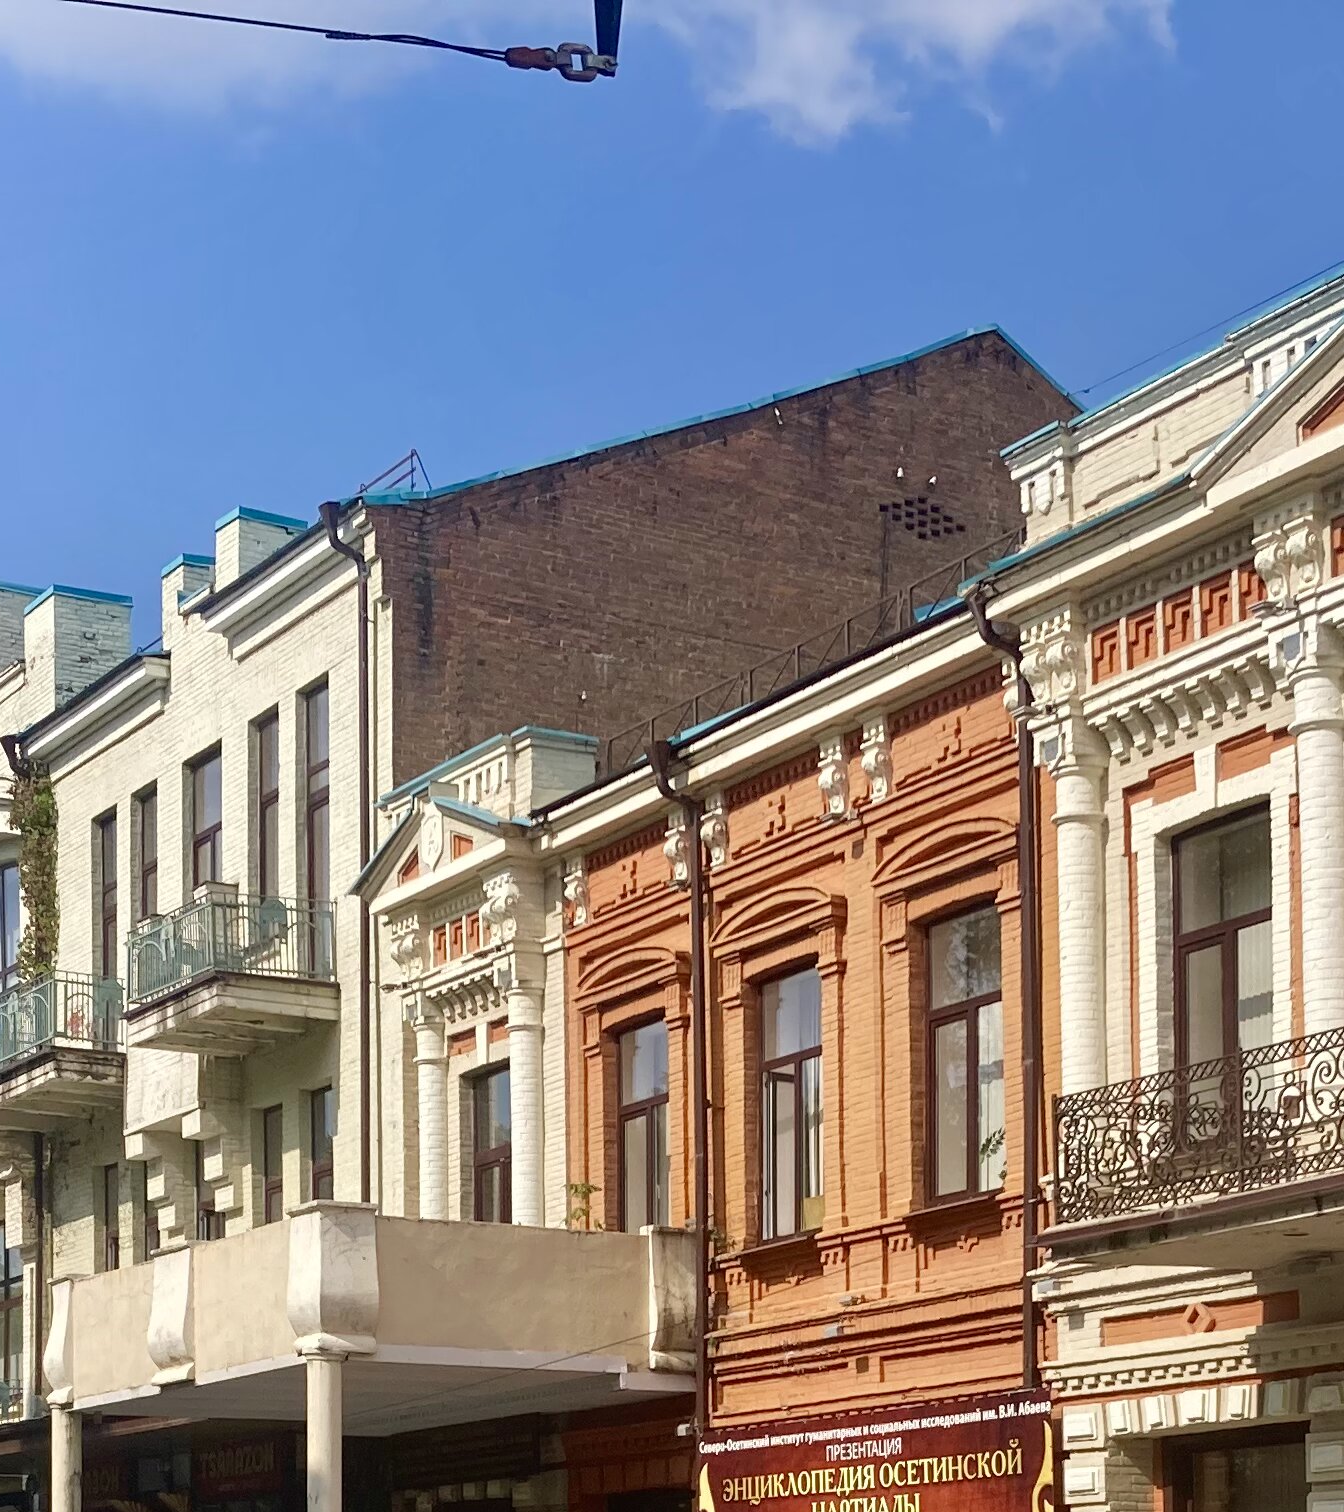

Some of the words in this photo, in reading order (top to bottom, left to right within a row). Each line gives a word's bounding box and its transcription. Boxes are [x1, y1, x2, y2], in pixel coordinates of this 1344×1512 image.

[699, 1435, 770, 1455] Северо-Осетинский
[770, 1433, 805, 1447] институт
[805, 1426, 862, 1445] гуманитарных
[869, 1418, 920, 1436] социальных
[921, 1408, 982, 1428] исследований
[983, 1410, 998, 1421] им.
[999, 1404, 1017, 1419] В.И.
[1018, 1400, 1051, 1416] Абаева
[826, 1437, 902, 1462] ПРЕЗЕНТАЦИЯ
[722, 1464, 875, 1505] ЭНЦИКЛОПЕДИЯ
[879, 1438, 1023, 1488] ОСЕТИНСКОЙ
